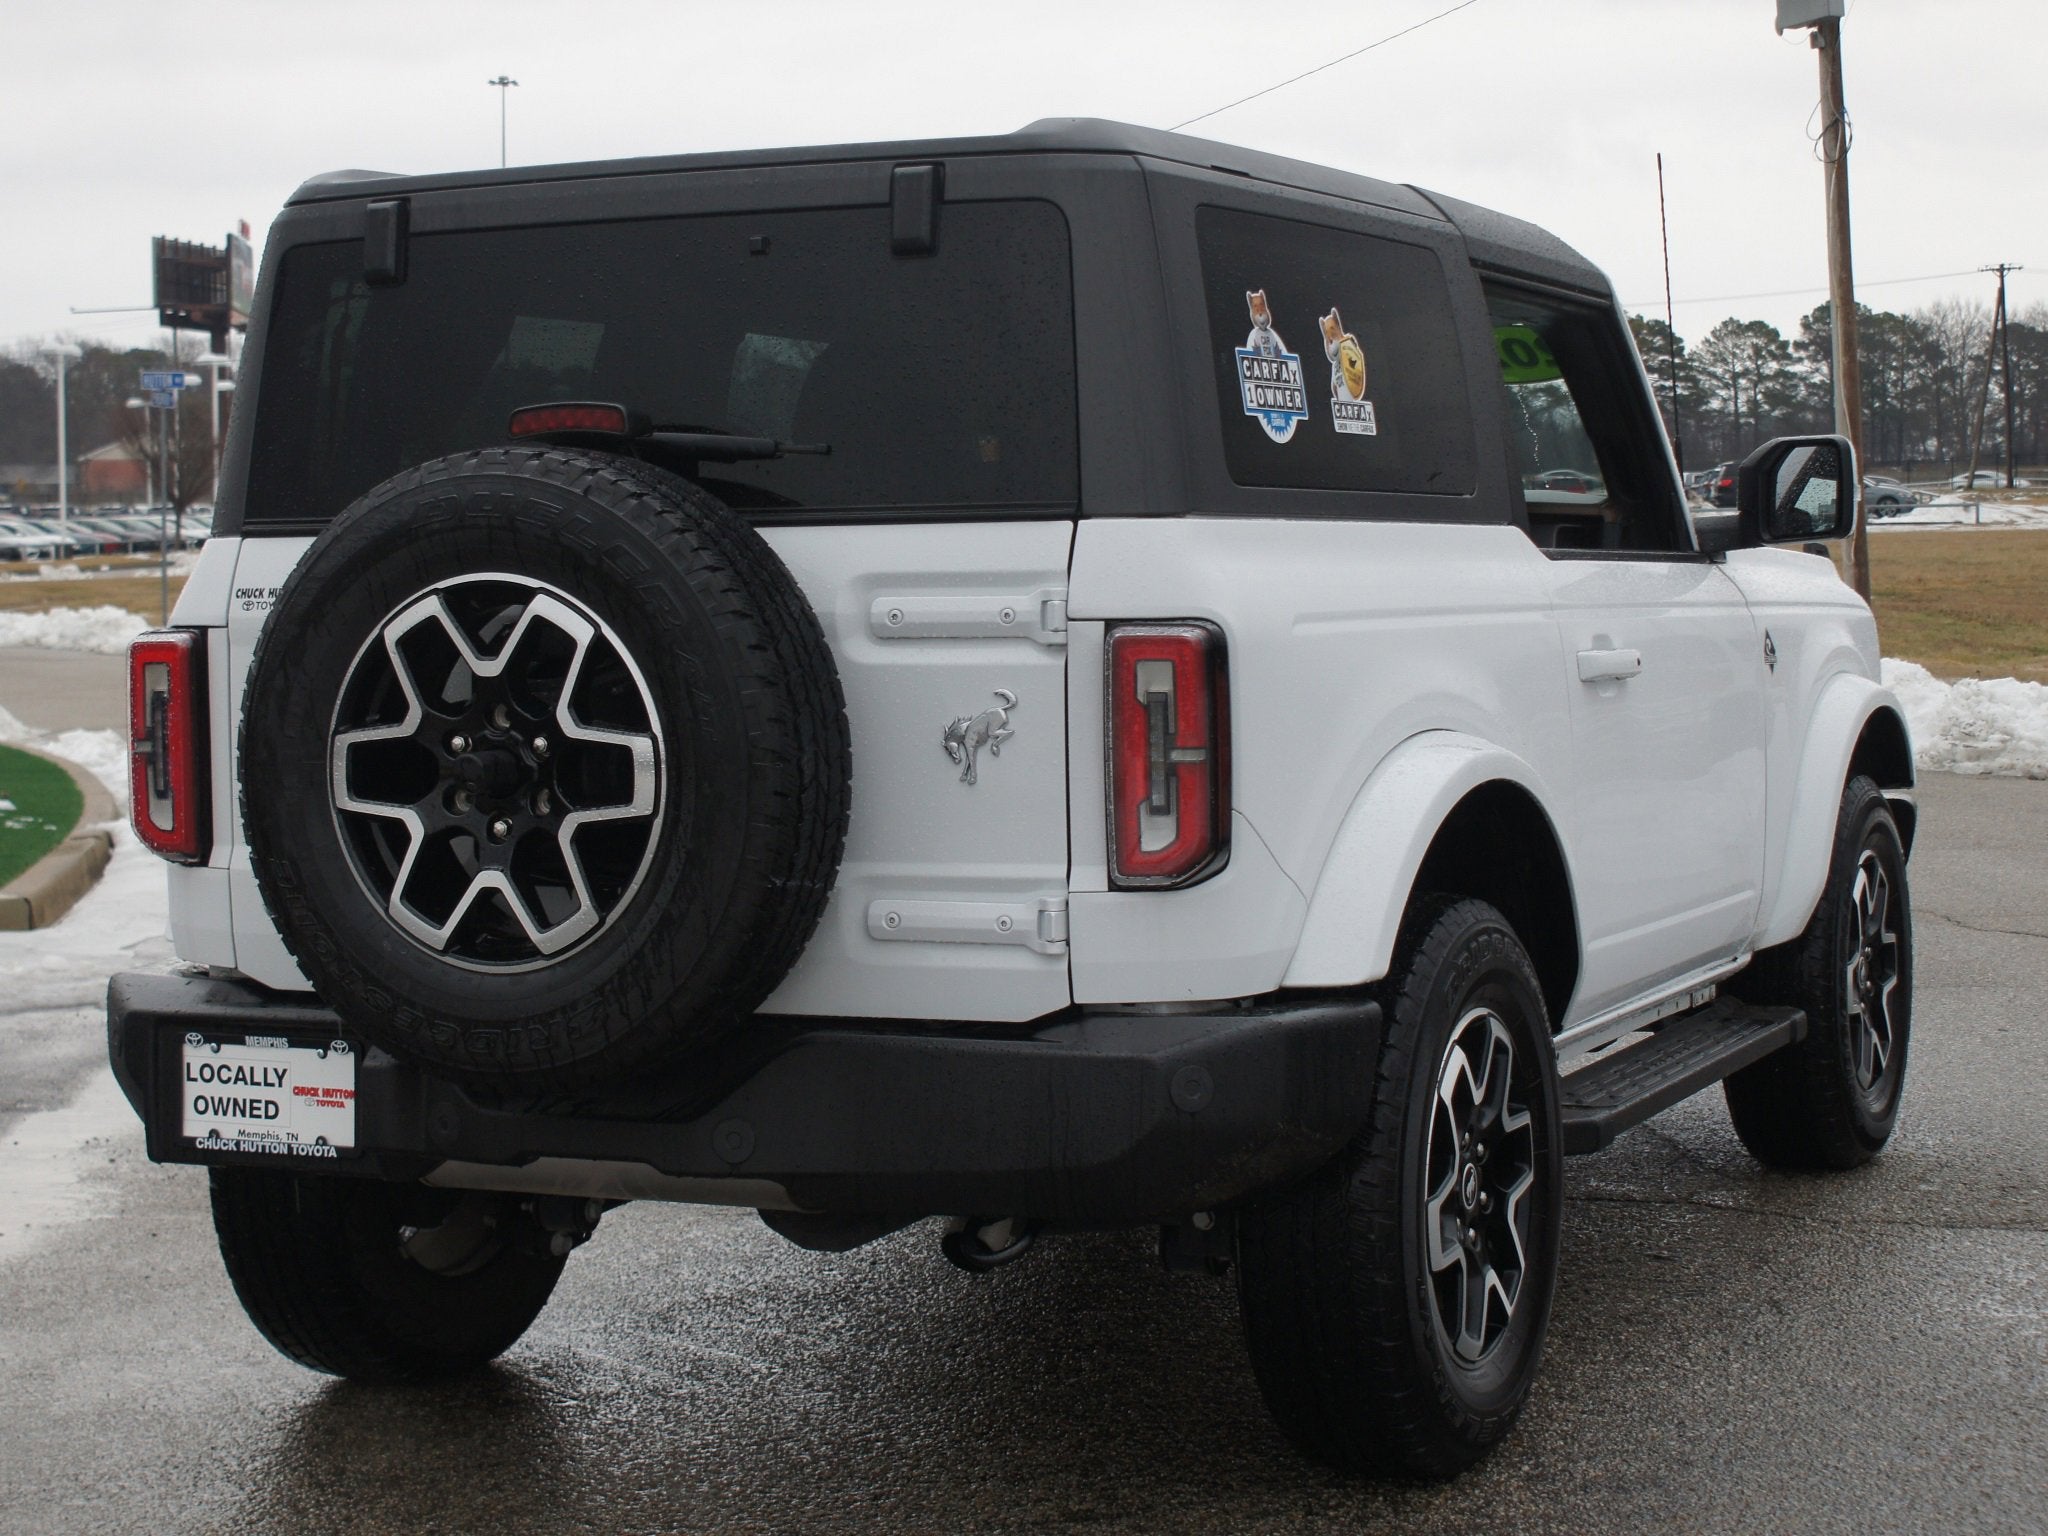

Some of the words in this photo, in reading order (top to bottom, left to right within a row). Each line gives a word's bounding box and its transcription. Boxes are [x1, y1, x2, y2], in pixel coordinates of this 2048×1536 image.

[1242, 357, 1299, 385] CARFAX
[1256, 386, 1303, 409] OWNER
[1335, 402, 1373, 422] CARFAX
[236, 588, 265, 599] CHUCK
[245, 1036, 289, 1048] MEMPHIS
[186, 1062, 288, 1088] LOCALLY
[194, 1095, 279, 1120] OWNED
[316, 1099, 345, 1109] TOYOTA
[237, 1129, 283, 1142] Memphis,
[286, 1132, 299, 1141] TN
[196, 1137, 237, 1151] CHUCK
[239, 1141, 288, 1155] HUTTON
[291, 1143, 337, 1158] TOYOTA
